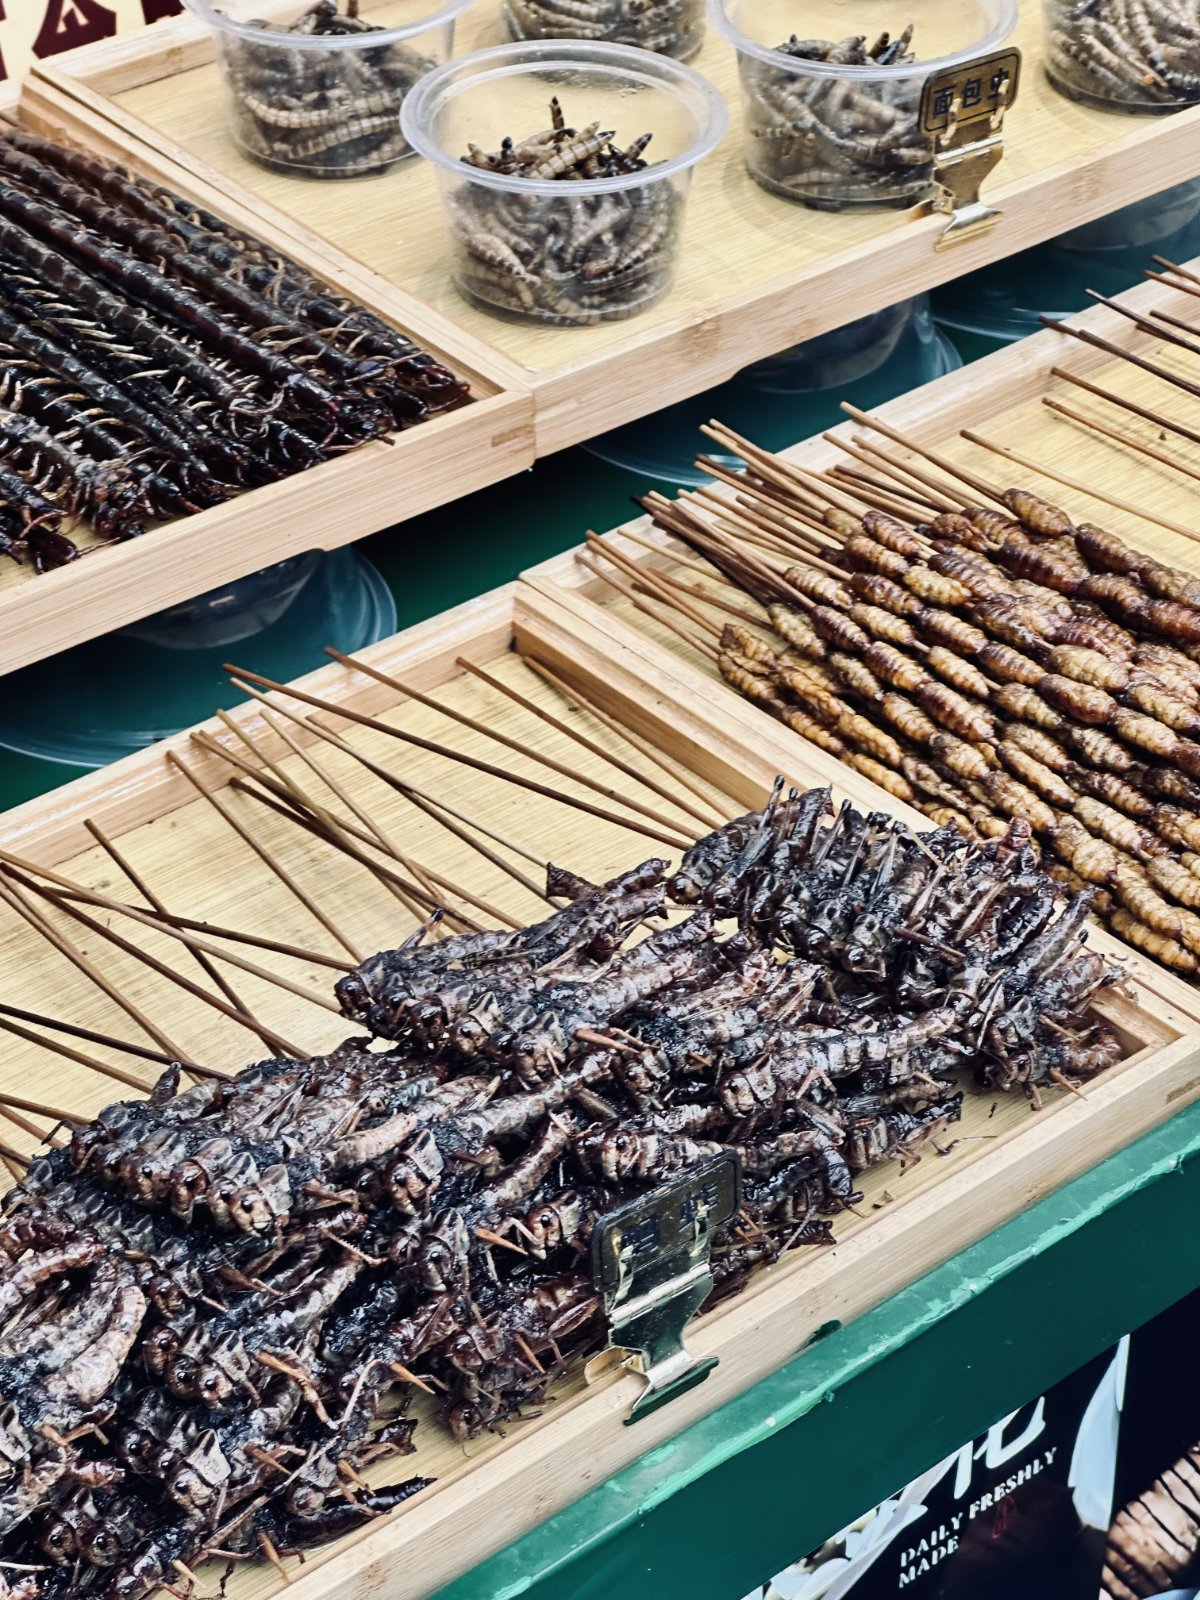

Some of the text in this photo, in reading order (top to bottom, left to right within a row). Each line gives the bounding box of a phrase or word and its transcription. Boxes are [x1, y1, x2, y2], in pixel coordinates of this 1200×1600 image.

[900, 1512, 963, 1567] DAILY
[969, 1447, 1057, 1519] FRESHLY
[899, 1535, 959, 1588] MADE
